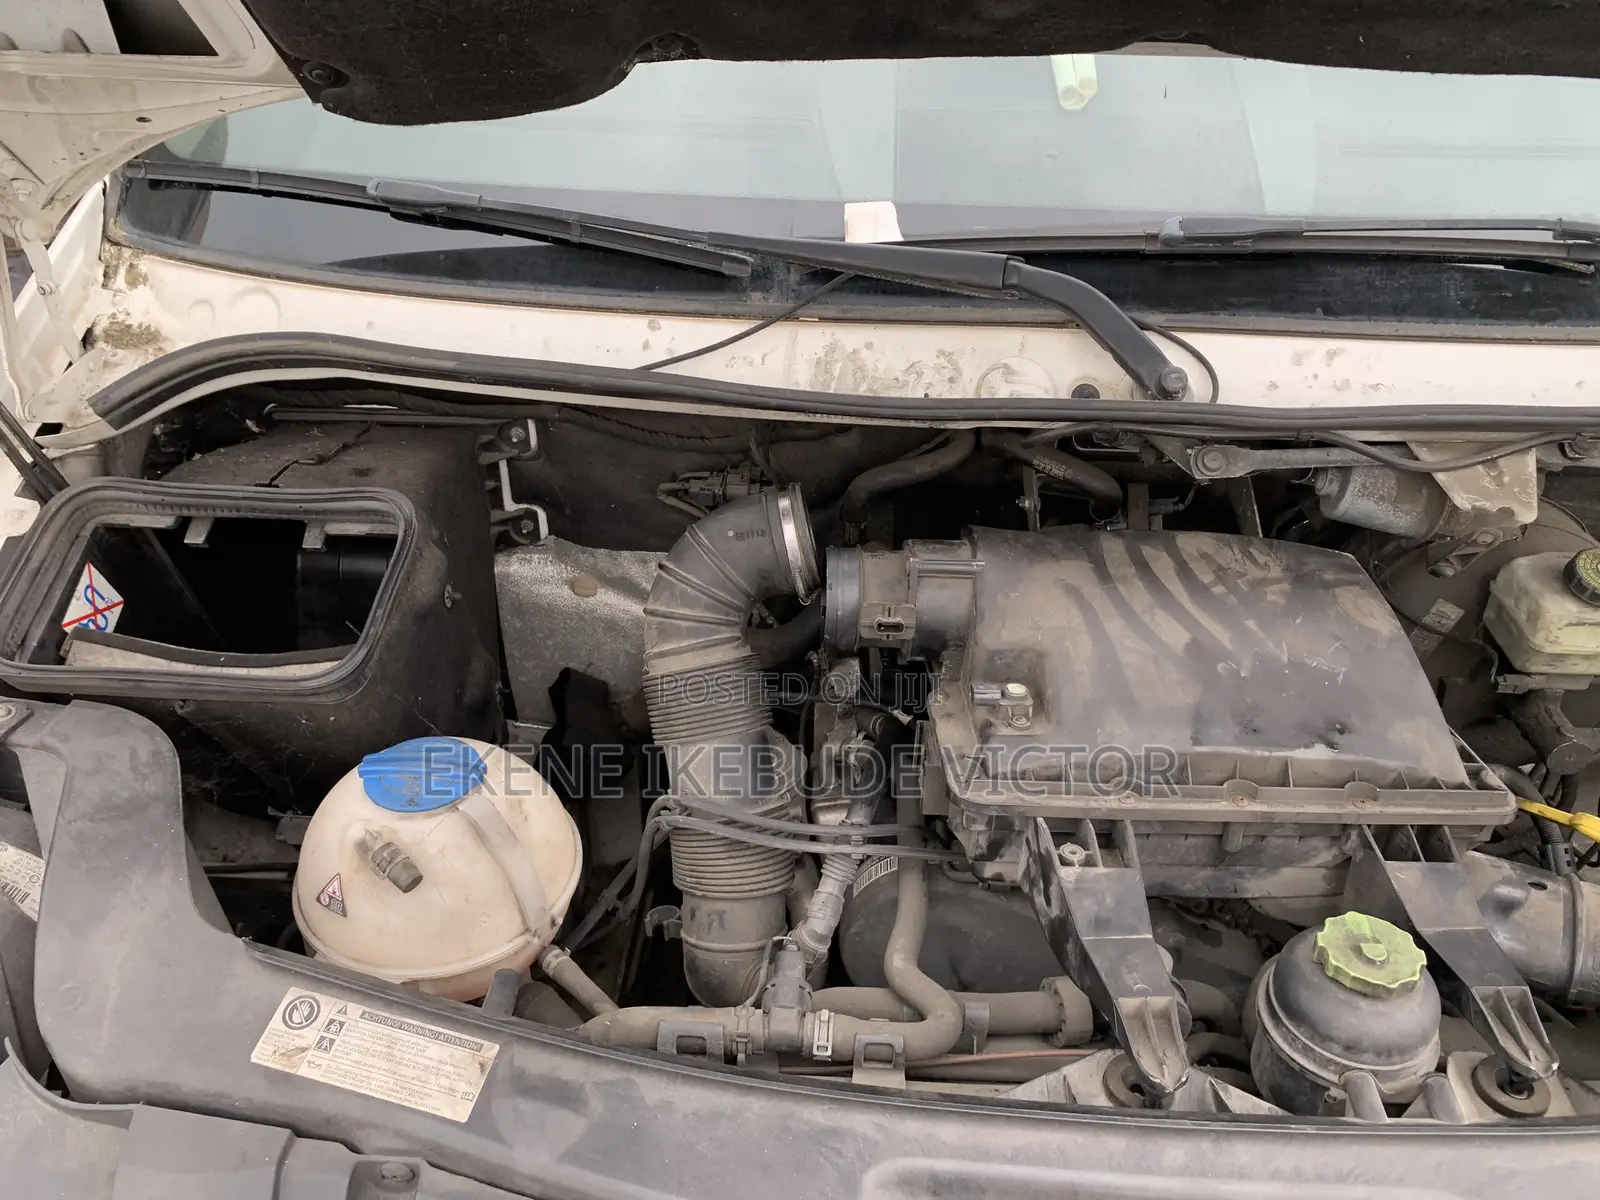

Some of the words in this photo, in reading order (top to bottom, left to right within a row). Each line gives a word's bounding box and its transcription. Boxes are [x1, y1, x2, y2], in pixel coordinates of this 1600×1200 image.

[361, 1012, 400, 1027] ACHTUNG!
[400, 1023, 438, 1038] WARNING!
[437, 1033, 481, 1051] ATTENTION!
